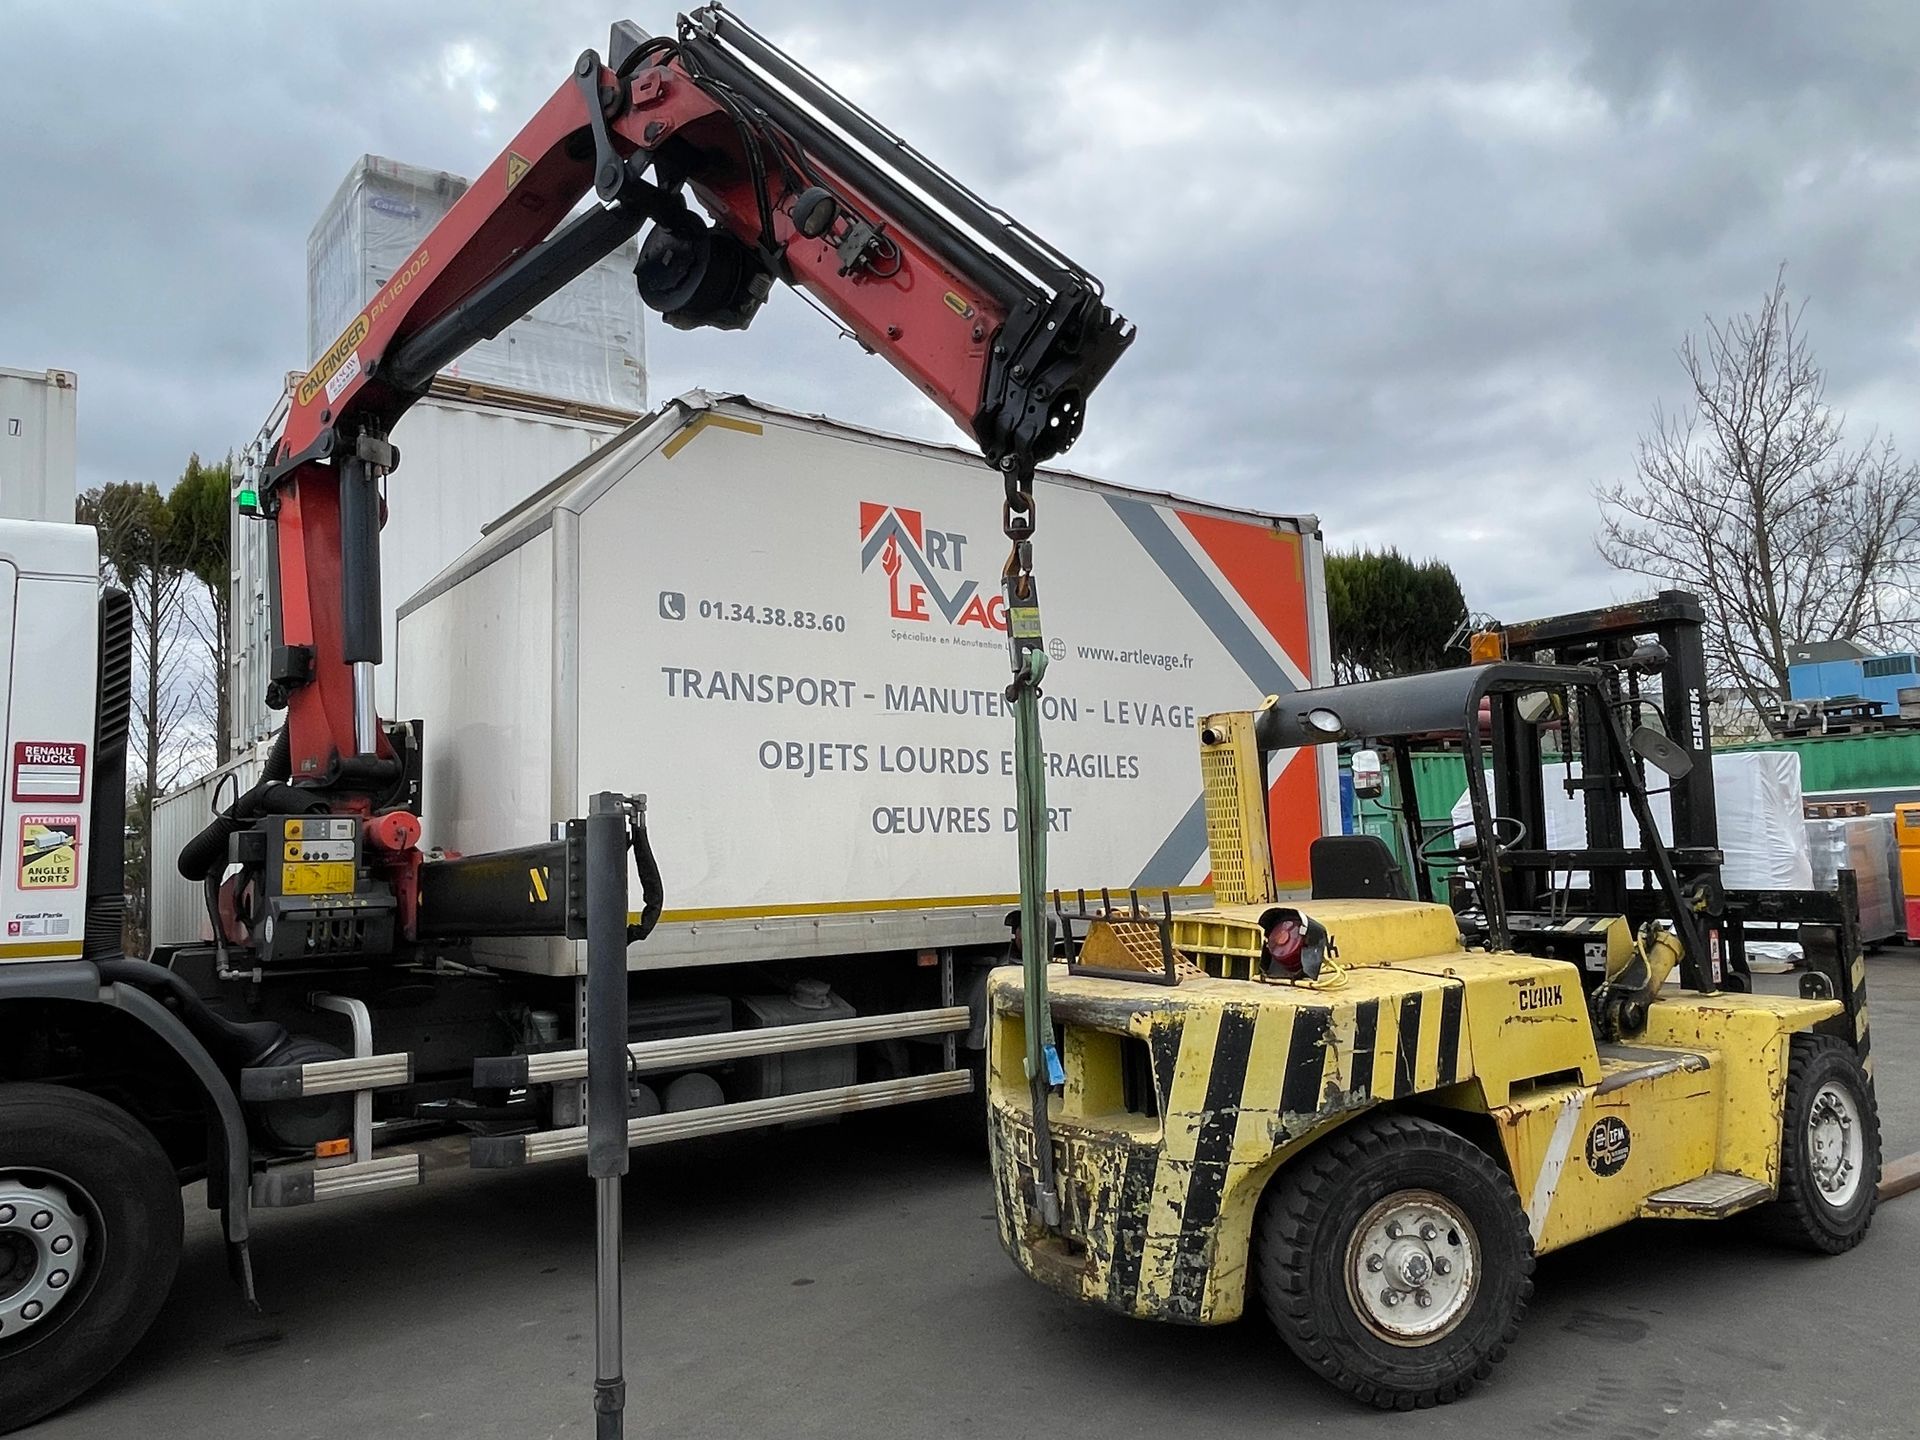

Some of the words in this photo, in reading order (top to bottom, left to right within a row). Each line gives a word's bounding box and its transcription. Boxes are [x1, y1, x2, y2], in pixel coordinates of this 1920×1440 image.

[302, 321, 366, 401] PALFINGER
[371, 295, 388, 322] PK
[389, 250, 430, 300] 16002
[890, 573, 1008, 631] LEVAG
[699, 600, 846, 632] 01.34.38.83.60
[891, 629, 937, 644] Spécialiste
[953, 636, 1003, 650] Manutention
[1077, 646, 1194, 671] www.artlevage.fr
[661, 667, 856, 708] TRANSPORT
[885, 684, 1077, 722] MANUTENON
[1103, 699, 1194, 728] LEVAGE
[1689, 688, 1704, 750] CLARK
[25, 745, 76, 756] RENAULT
[25, 754, 76, 764] TRUCKS
[759, 740, 868, 778] OBJETS
[880, 745, 989, 775] LOURDS
[24, 816, 78, 824] ATTENTION
[872, 806, 991, 834] ŒUVRES
[1004, 807, 1072, 832] DRT
[28, 866, 70, 875] ANGLES
[29, 875, 68, 883] MORTS
[15, 912, 41, 920] Grand
